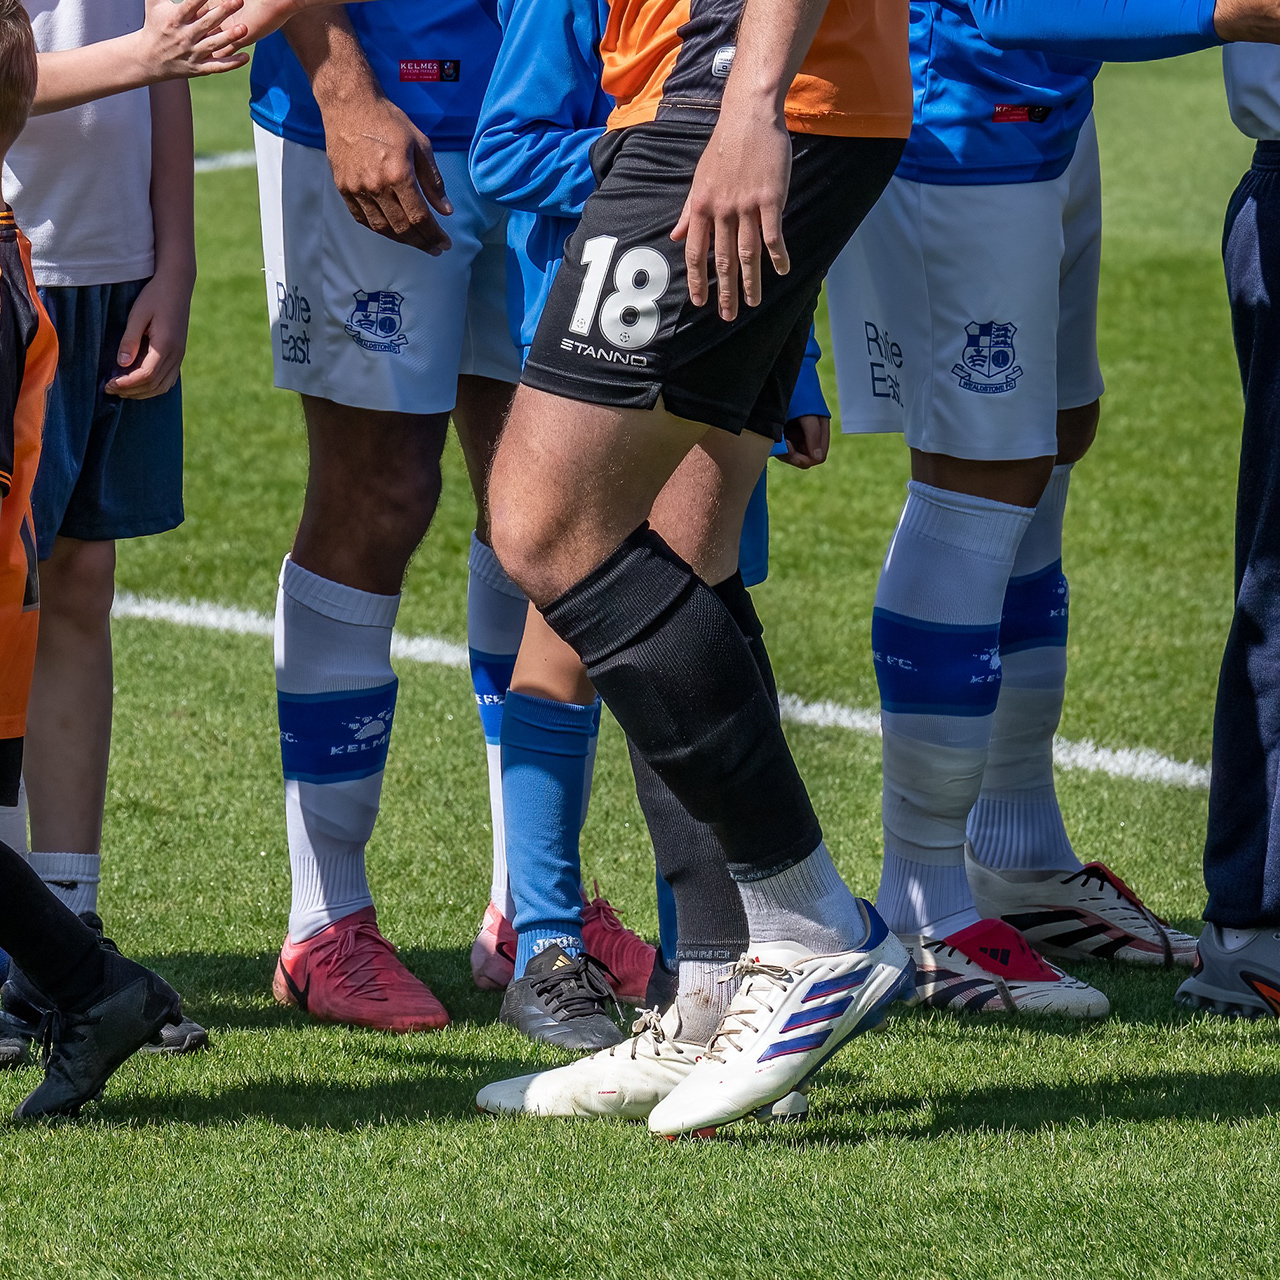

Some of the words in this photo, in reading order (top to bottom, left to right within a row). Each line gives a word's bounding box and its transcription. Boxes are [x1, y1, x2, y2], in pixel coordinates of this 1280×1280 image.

[400, 62, 433, 70] KELME
[568, 234, 671, 351] 18
[560, 338, 648, 367] STANNO
